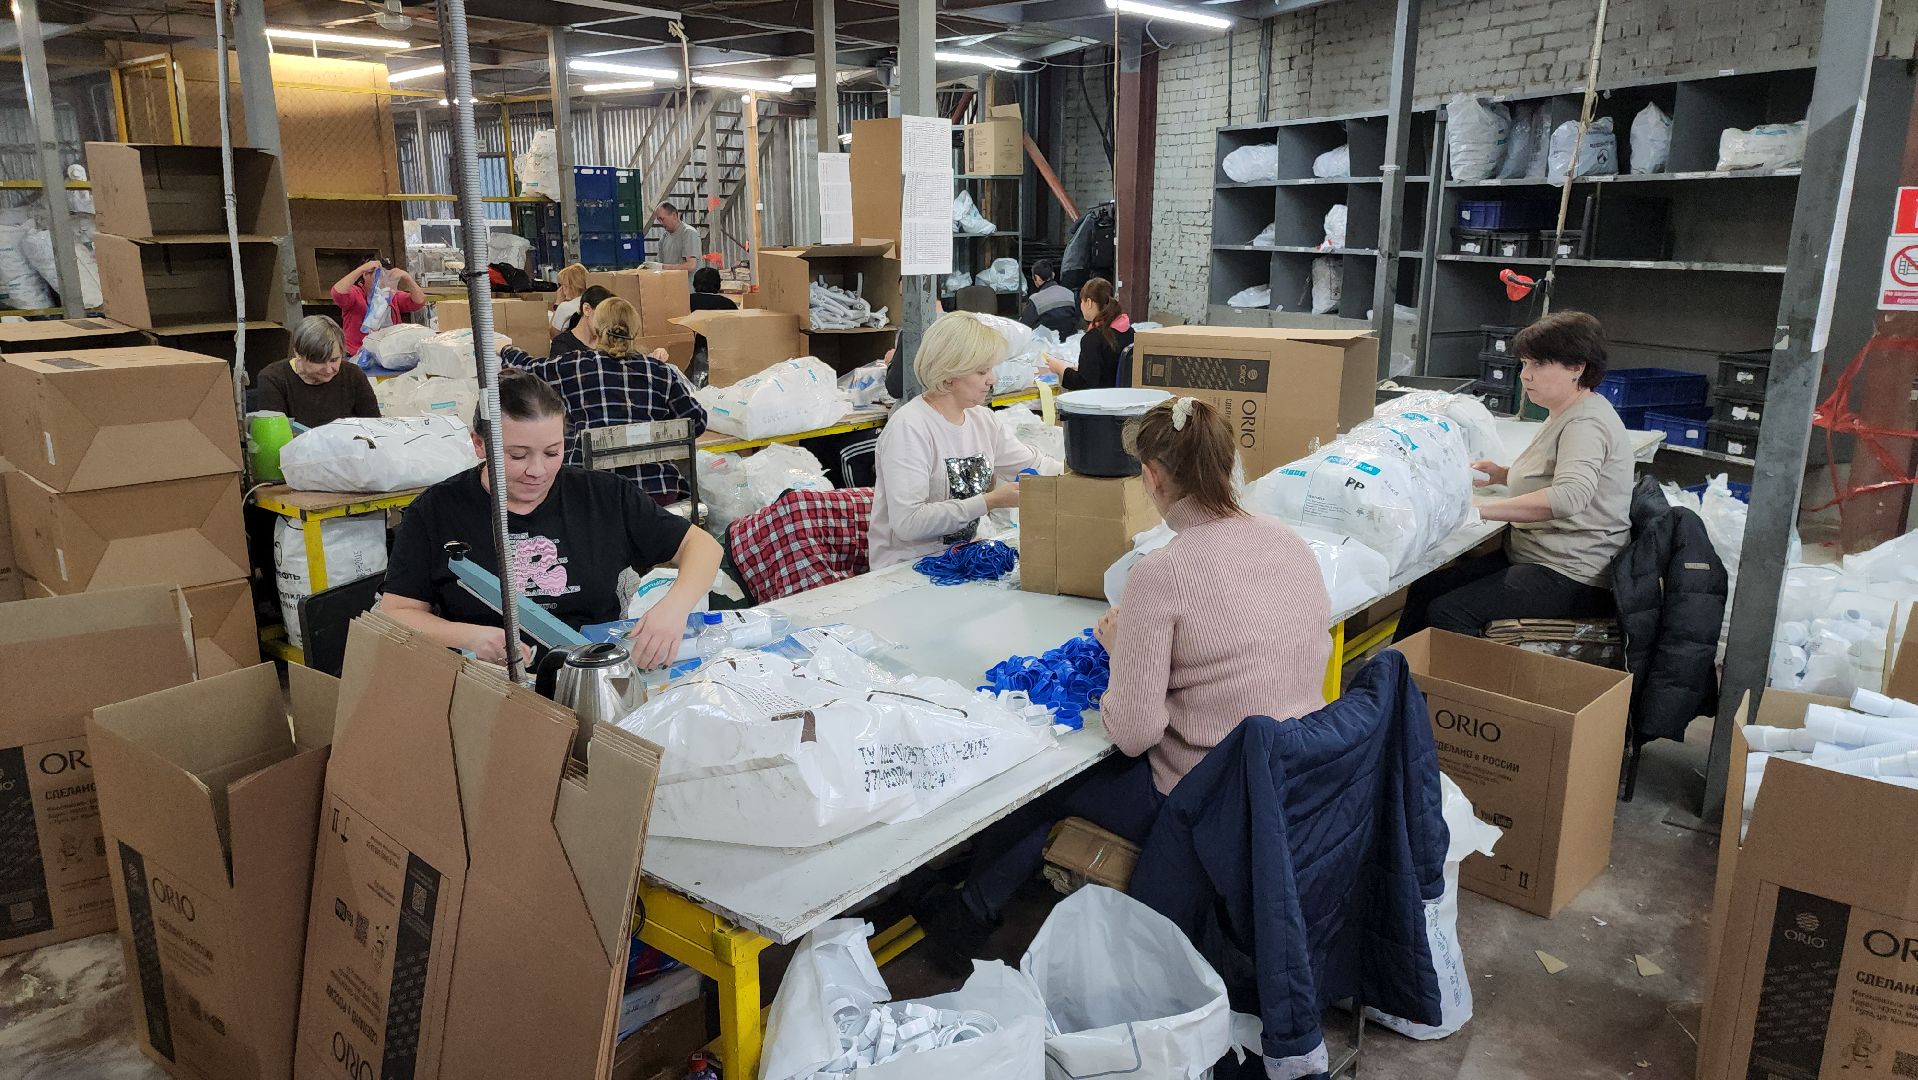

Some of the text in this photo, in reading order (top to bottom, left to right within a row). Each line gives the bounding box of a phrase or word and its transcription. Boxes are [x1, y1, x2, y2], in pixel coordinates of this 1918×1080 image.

[1225, 398, 1233, 418] СДЕЛ
[1240, 399, 1257, 449] ORIO
[1344, 476, 1365, 491] PP
[1435, 709, 1501, 742] ORIO
[39, 750, 92, 775] OR
[1482, 752, 1520, 773] РОССИИ
[152, 877, 195, 922] ORIO
[1784, 929, 1829, 949] ORIO
[1863, 929, 1918, 962] OR
[1856, 970, 1918, 996] СДЕЛАН
